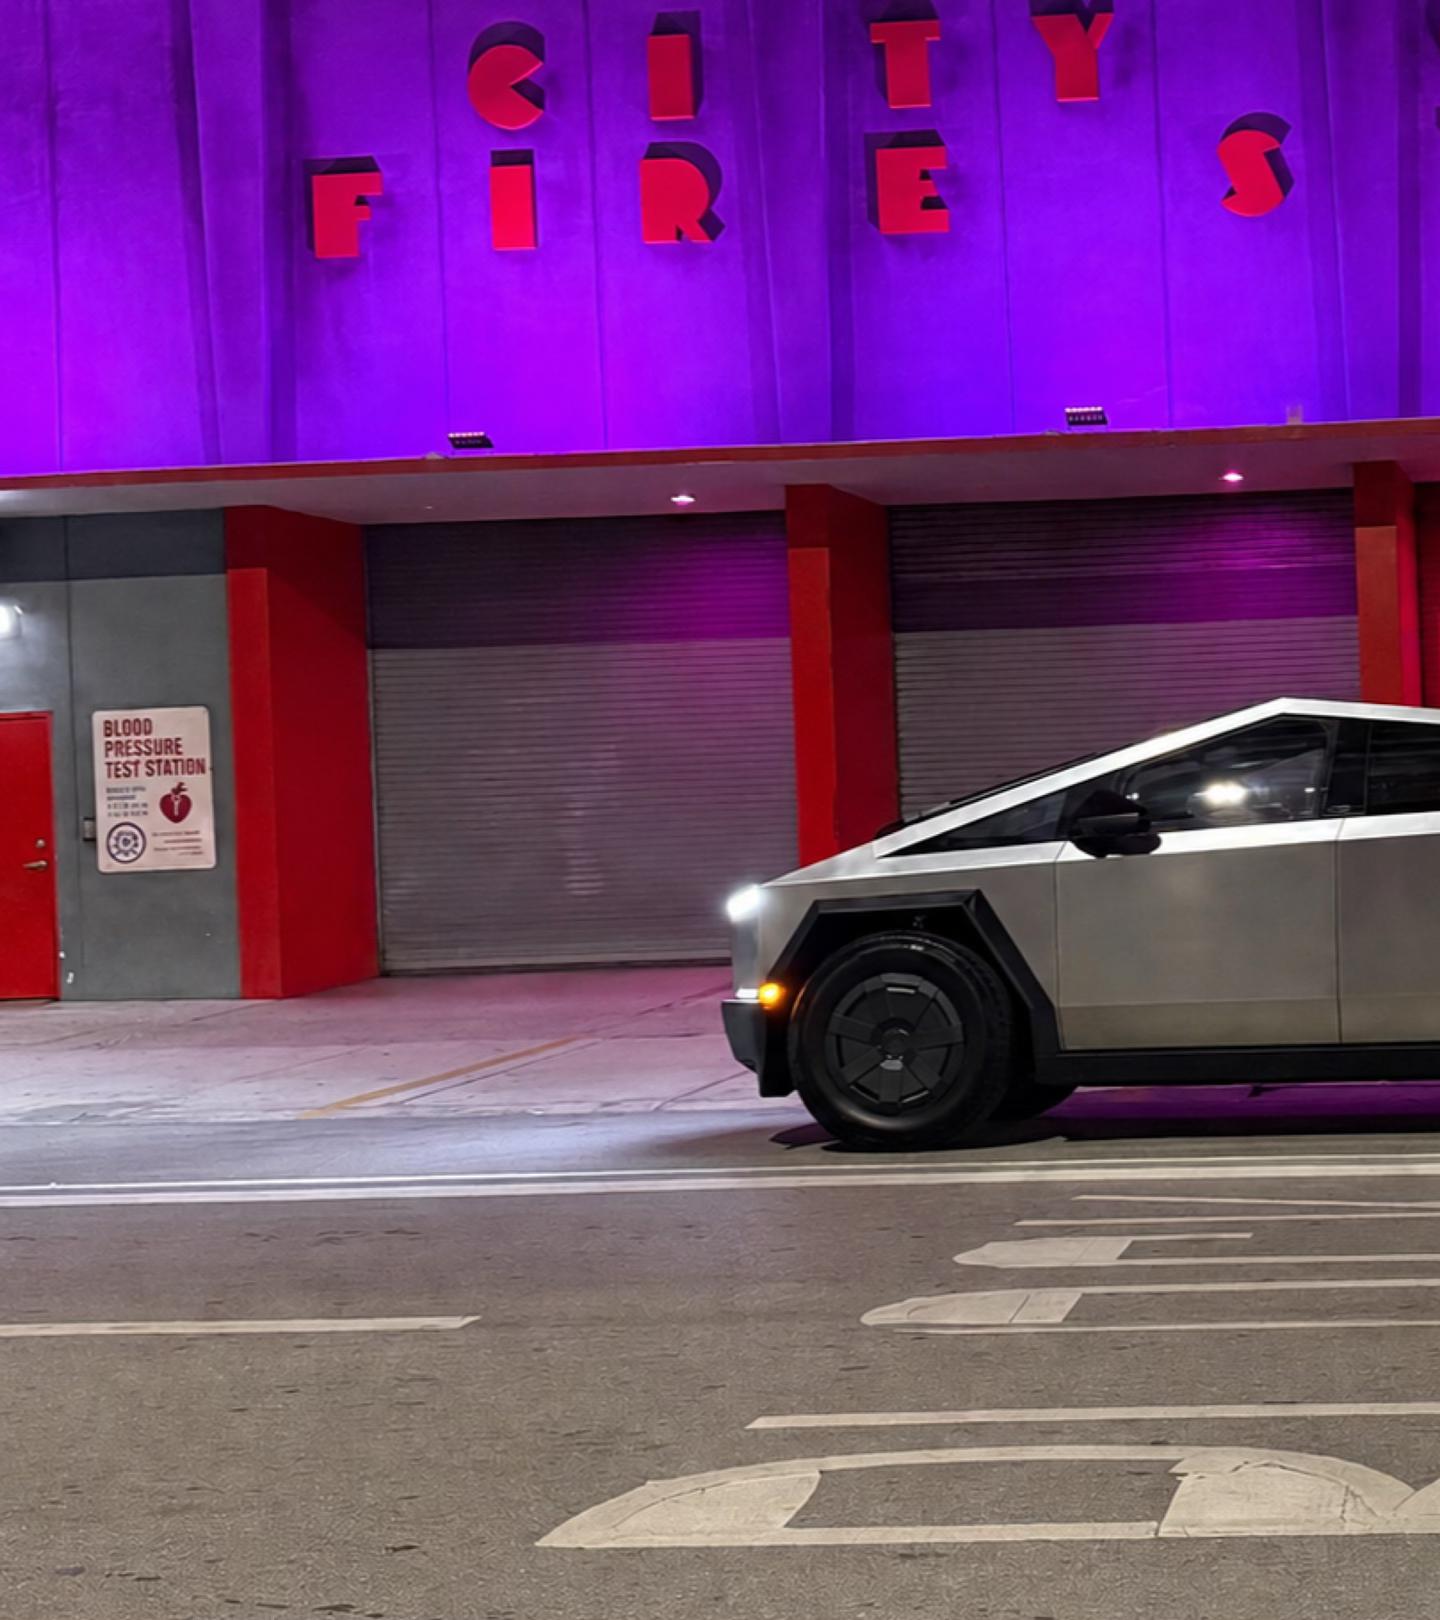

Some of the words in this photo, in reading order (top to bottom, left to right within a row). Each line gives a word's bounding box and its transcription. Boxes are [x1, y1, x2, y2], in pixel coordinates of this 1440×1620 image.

[467, 11, 1114, 130] CITY
[311, 145, 950, 259] FIRE
[103, 718, 153, 738] BLOOD
[104, 738, 183, 758] PRESSURE
[105, 760, 141, 778] TEST
[145, 758, 206, 777] STATION
